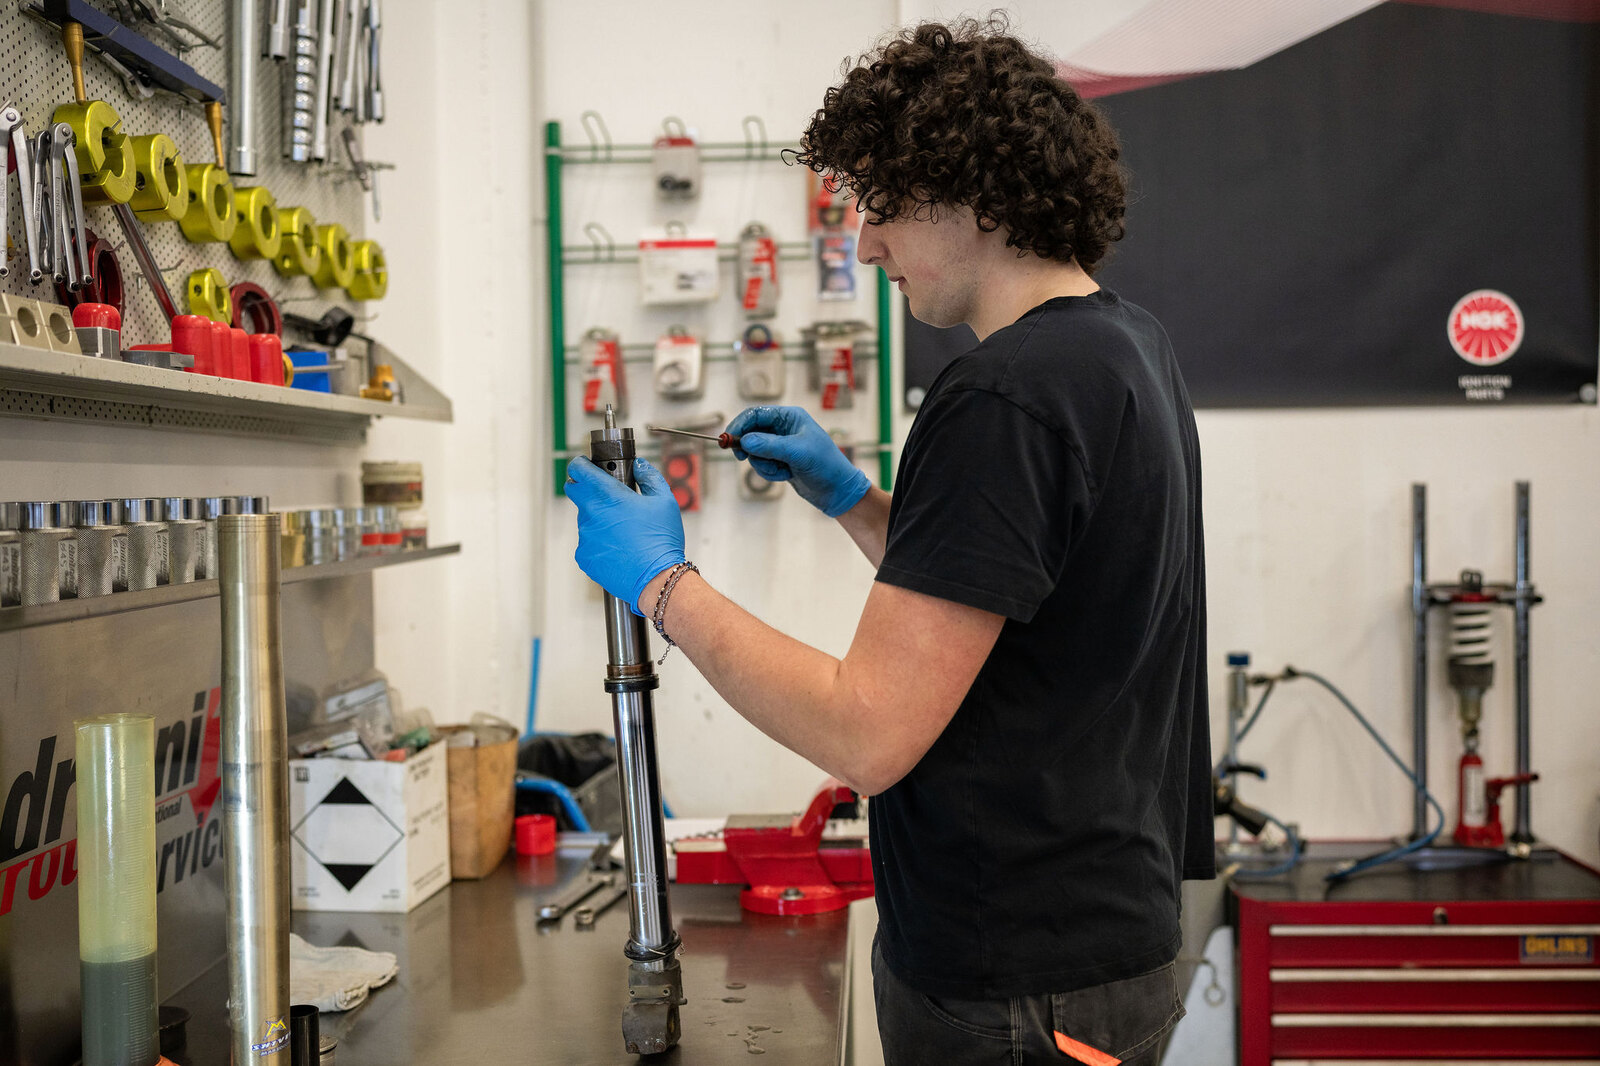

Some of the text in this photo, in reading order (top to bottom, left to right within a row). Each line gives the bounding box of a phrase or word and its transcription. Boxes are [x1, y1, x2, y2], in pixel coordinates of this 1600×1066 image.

[1460, 309, 1509, 331] NGK
[1458, 375, 1512, 388] IGNITION
[1465, 388, 1505, 400] PARTS
